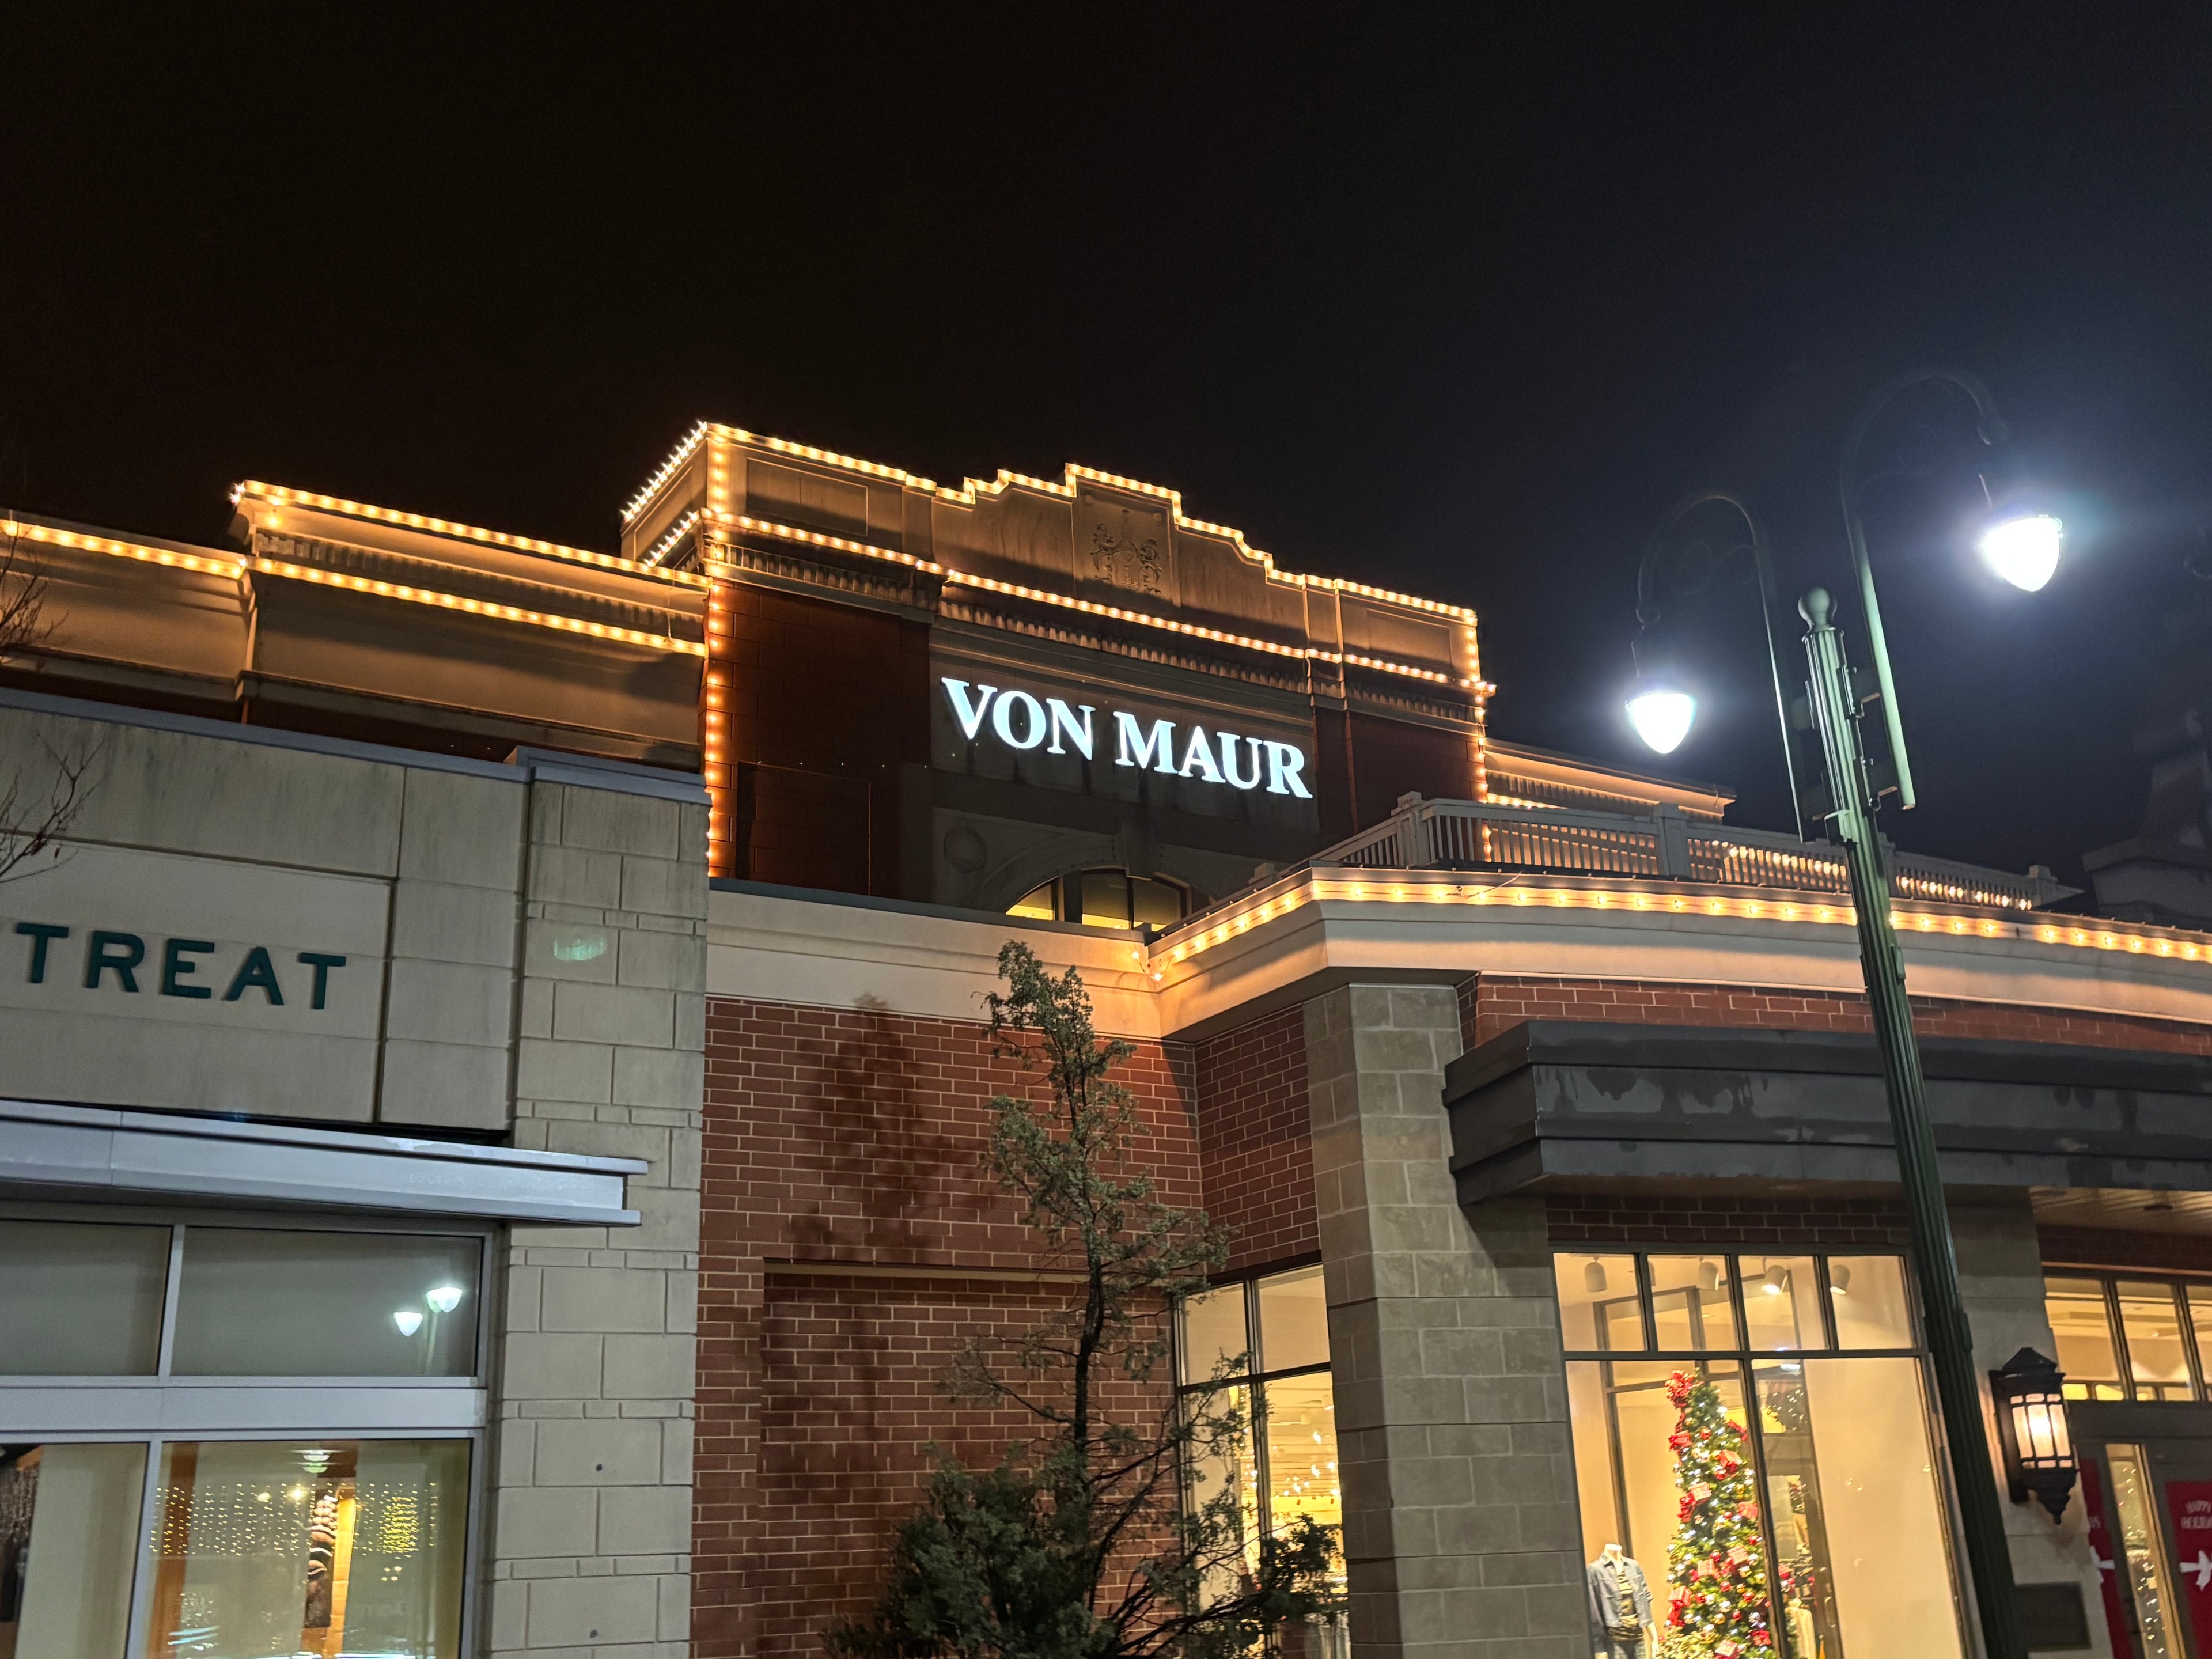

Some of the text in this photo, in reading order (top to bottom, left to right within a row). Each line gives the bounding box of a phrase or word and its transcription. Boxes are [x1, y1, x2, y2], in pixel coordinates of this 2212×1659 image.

[941, 677, 1313, 798] VON MAUR
[15, 922, 346, 1010] TREAT
